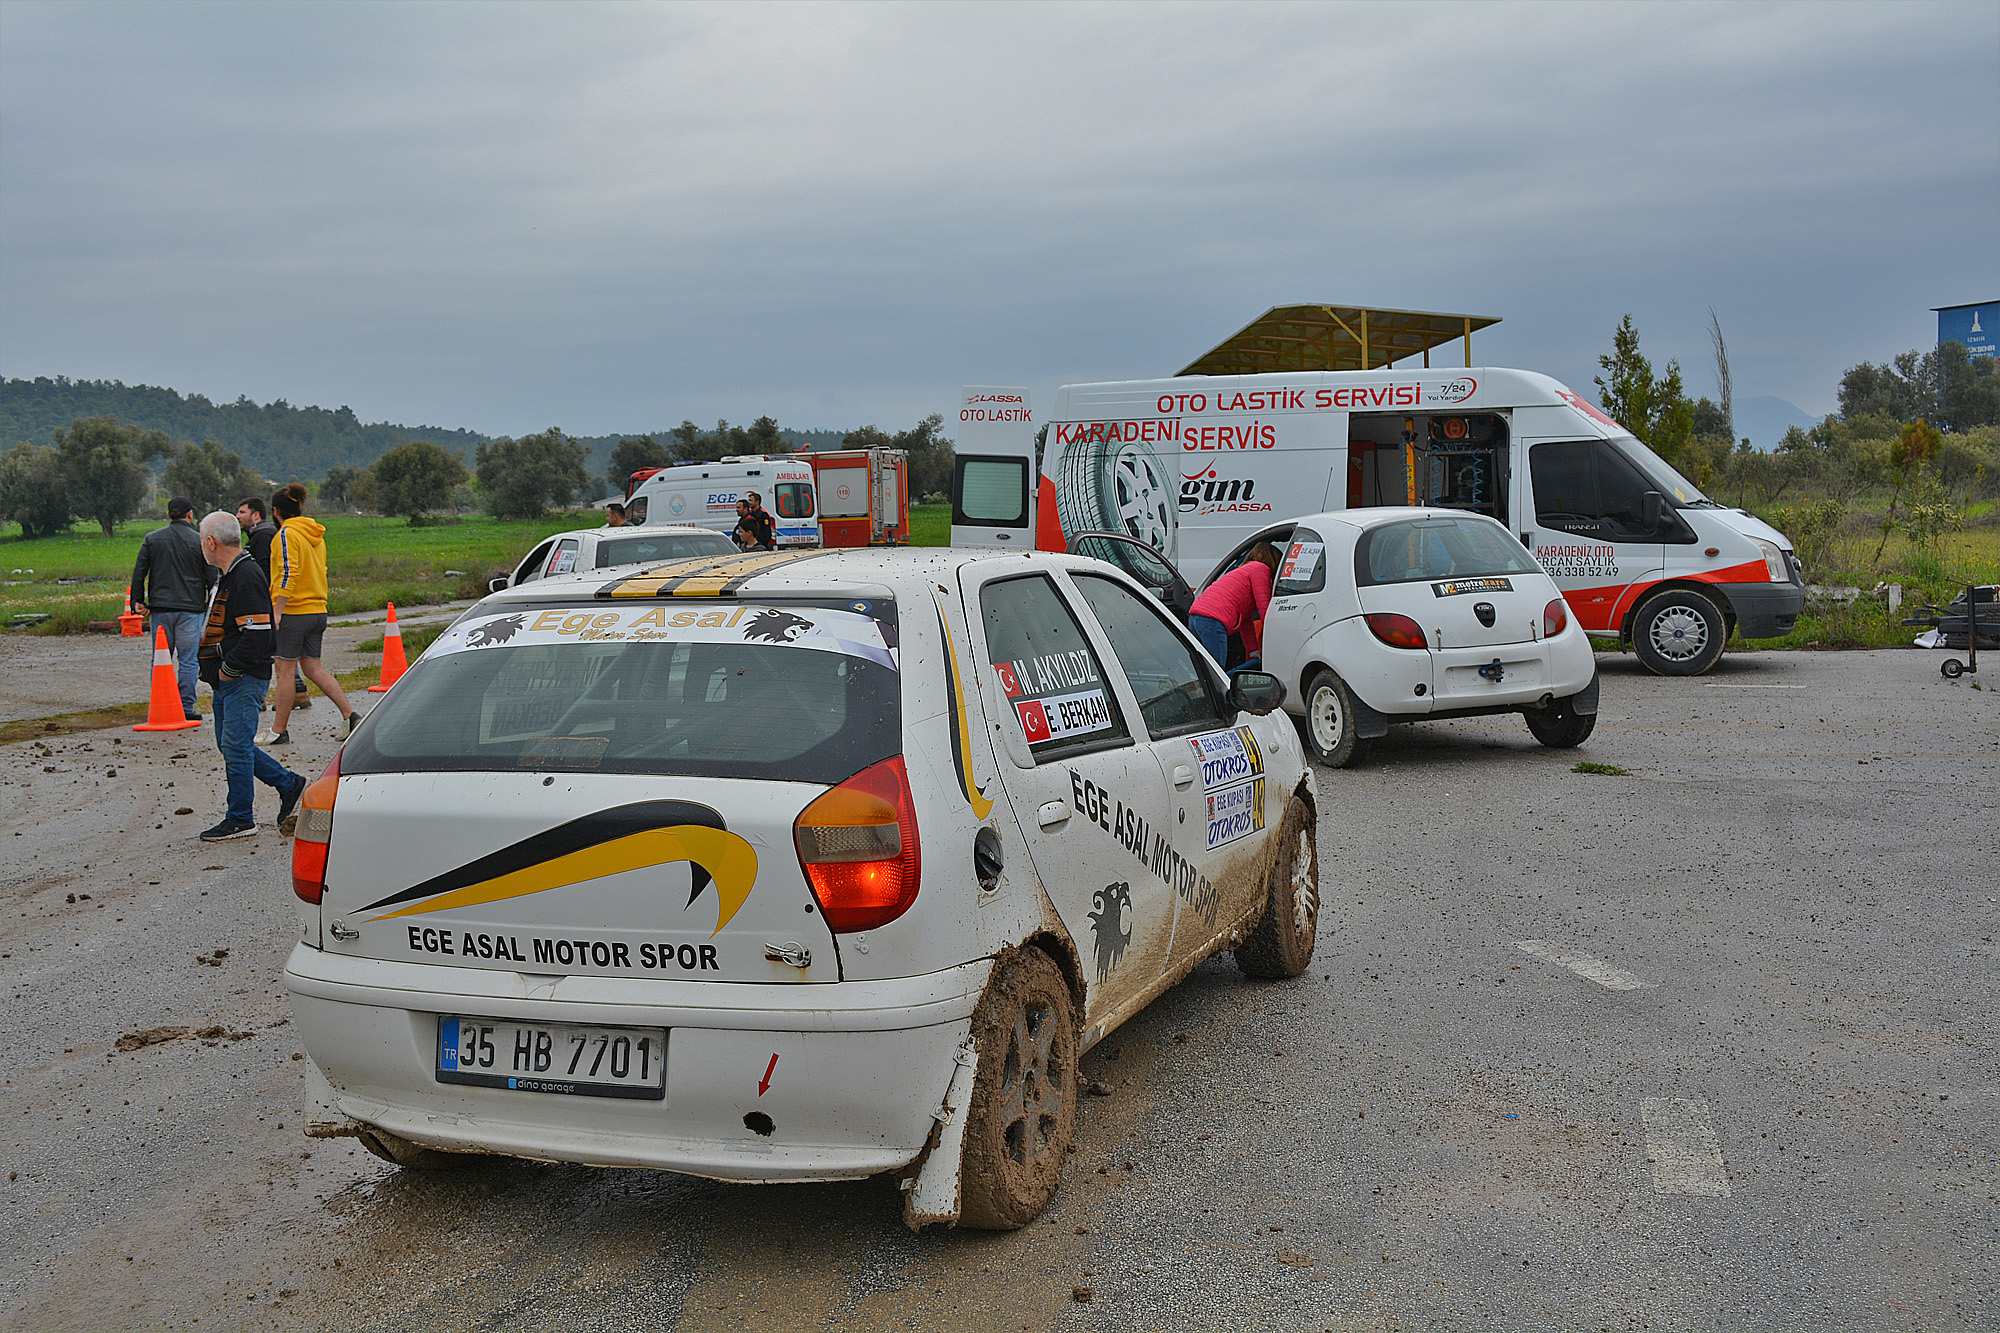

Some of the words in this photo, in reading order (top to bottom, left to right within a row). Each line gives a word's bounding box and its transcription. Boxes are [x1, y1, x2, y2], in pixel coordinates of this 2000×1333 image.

[1441, 382, 1466, 395] 7/24
[980, 395, 1023, 403] LASSA
[1157, 394, 1207, 414] OTO
[1217, 387, 1306, 411] LASTİK
[1315, 382, 1421, 408] SERVİSİ
[960, 409, 985, 421] OTO
[988, 406, 1032, 421] LASTİK
[1183, 421, 1276, 451] SERVİS
[706, 493, 738, 504] EGE
[1216, 503, 1272, 512] LASSA
[1537, 544, 1592, 557] KARADENİZ
[1595, 545, 1614, 557] OTO
[1576, 557, 1616, 566] SAYLIK
[1564, 567, 1585, 577] 338
[1588, 567, 1602, 577] 52
[1605, 567, 1619, 577] 49
[529, 610, 621, 635] Ege
[627, 607, 748, 628] Asal
[1044, 704, 1061, 733] E.
[1058, 695, 1109, 730] BERKAN
[1201, 738, 1216, 753] EGE
[1203, 753, 1248, 785] OTOKROS
[1217, 795, 1227, 811] EGE
[1253, 779, 1266, 829] 43
[1207, 810, 1251, 845] OTOKROS
[1069, 770, 1109, 833] EGE
[1113, 800, 1150, 866] ASAL
[1151, 832, 1197, 906] MOTOR
[407, 926, 455, 955] EGE
[462, 933, 527, 962] ASAL
[532, 938, 632, 968] MOTOR
[640, 943, 720, 971] SPOR
[444, 1048, 457, 1060] TR
[460, 1026, 495, 1068] 35
[513, 1030, 553, 1073] HB
[567, 1033, 650, 1080] 7701
[517, 1079, 539, 1089] dino
[541, 1083, 575, 1093] garage
